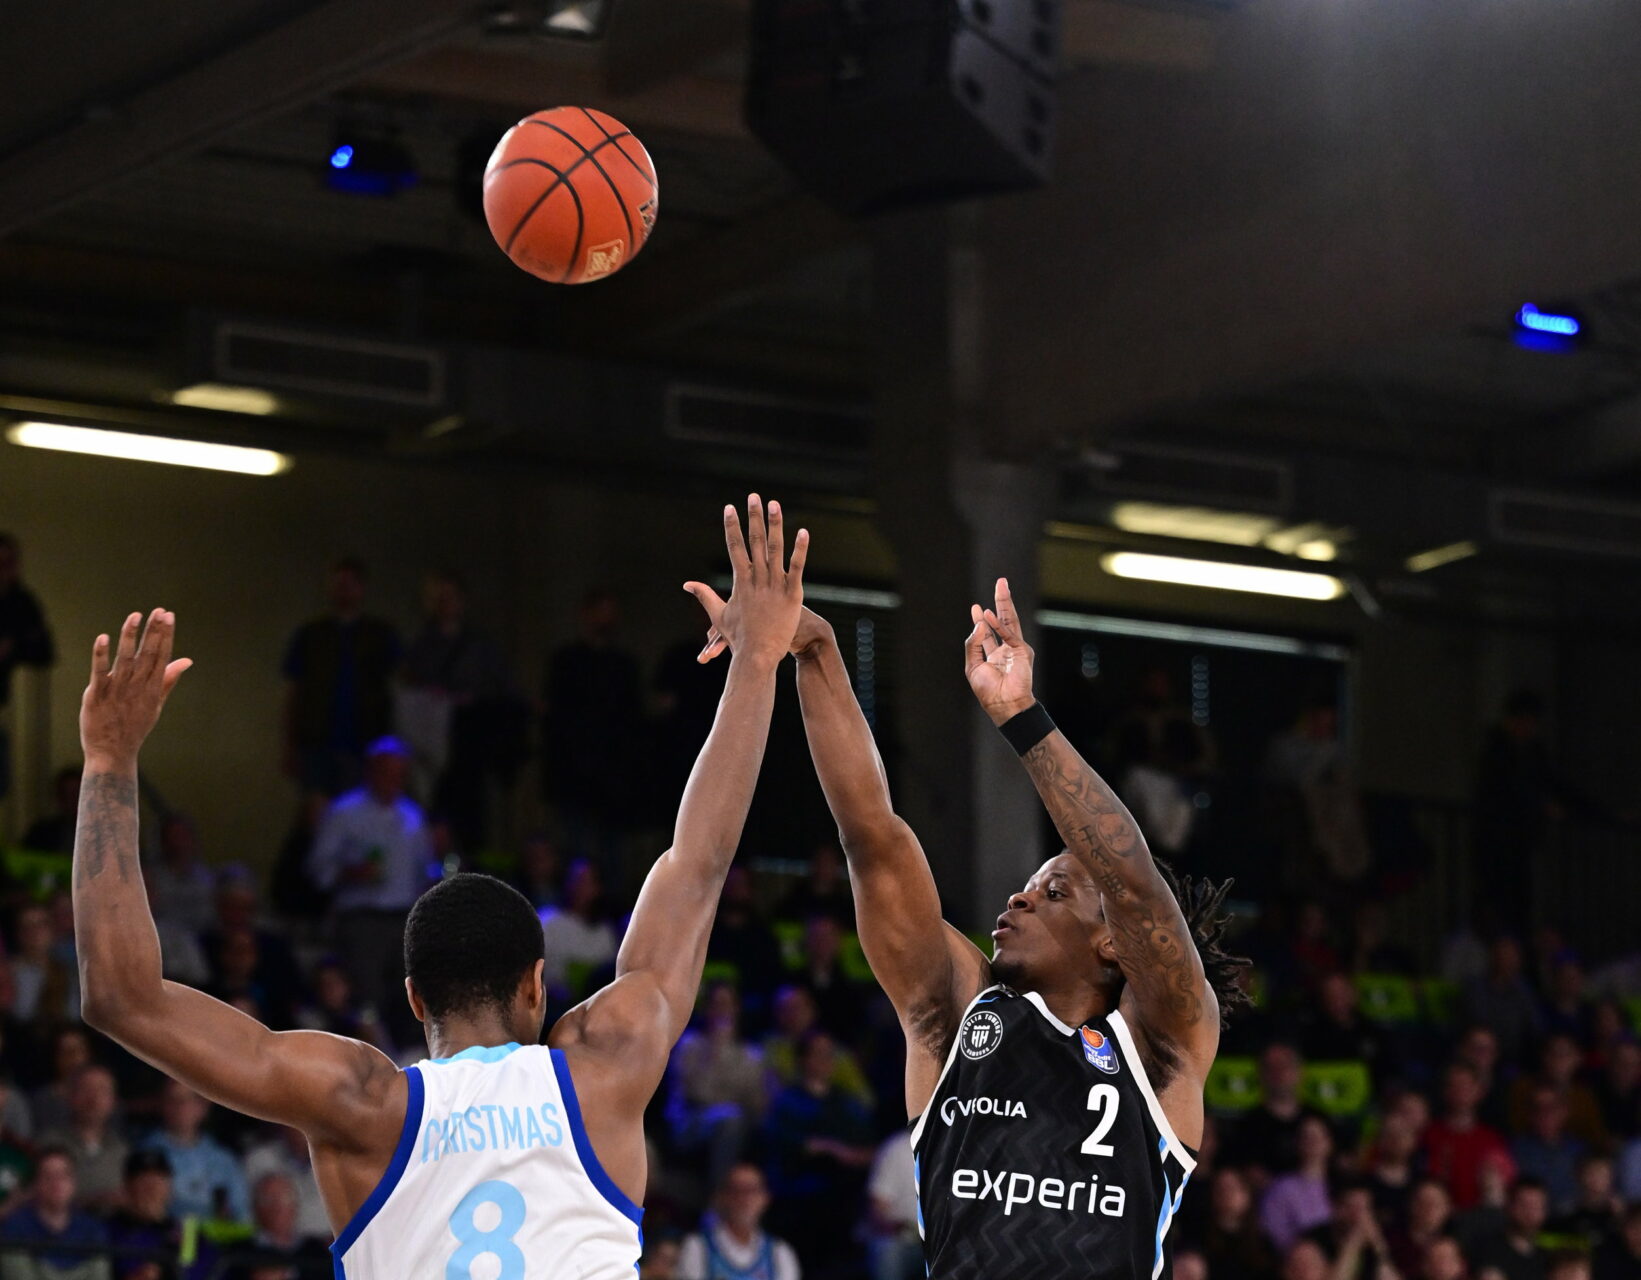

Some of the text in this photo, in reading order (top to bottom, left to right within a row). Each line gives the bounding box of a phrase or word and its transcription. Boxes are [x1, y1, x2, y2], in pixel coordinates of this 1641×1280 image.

[1087, 1052, 1114, 1070] BBL
[1081, 1084, 1120, 1157] 2
[952, 1169, 1126, 1217] experia
